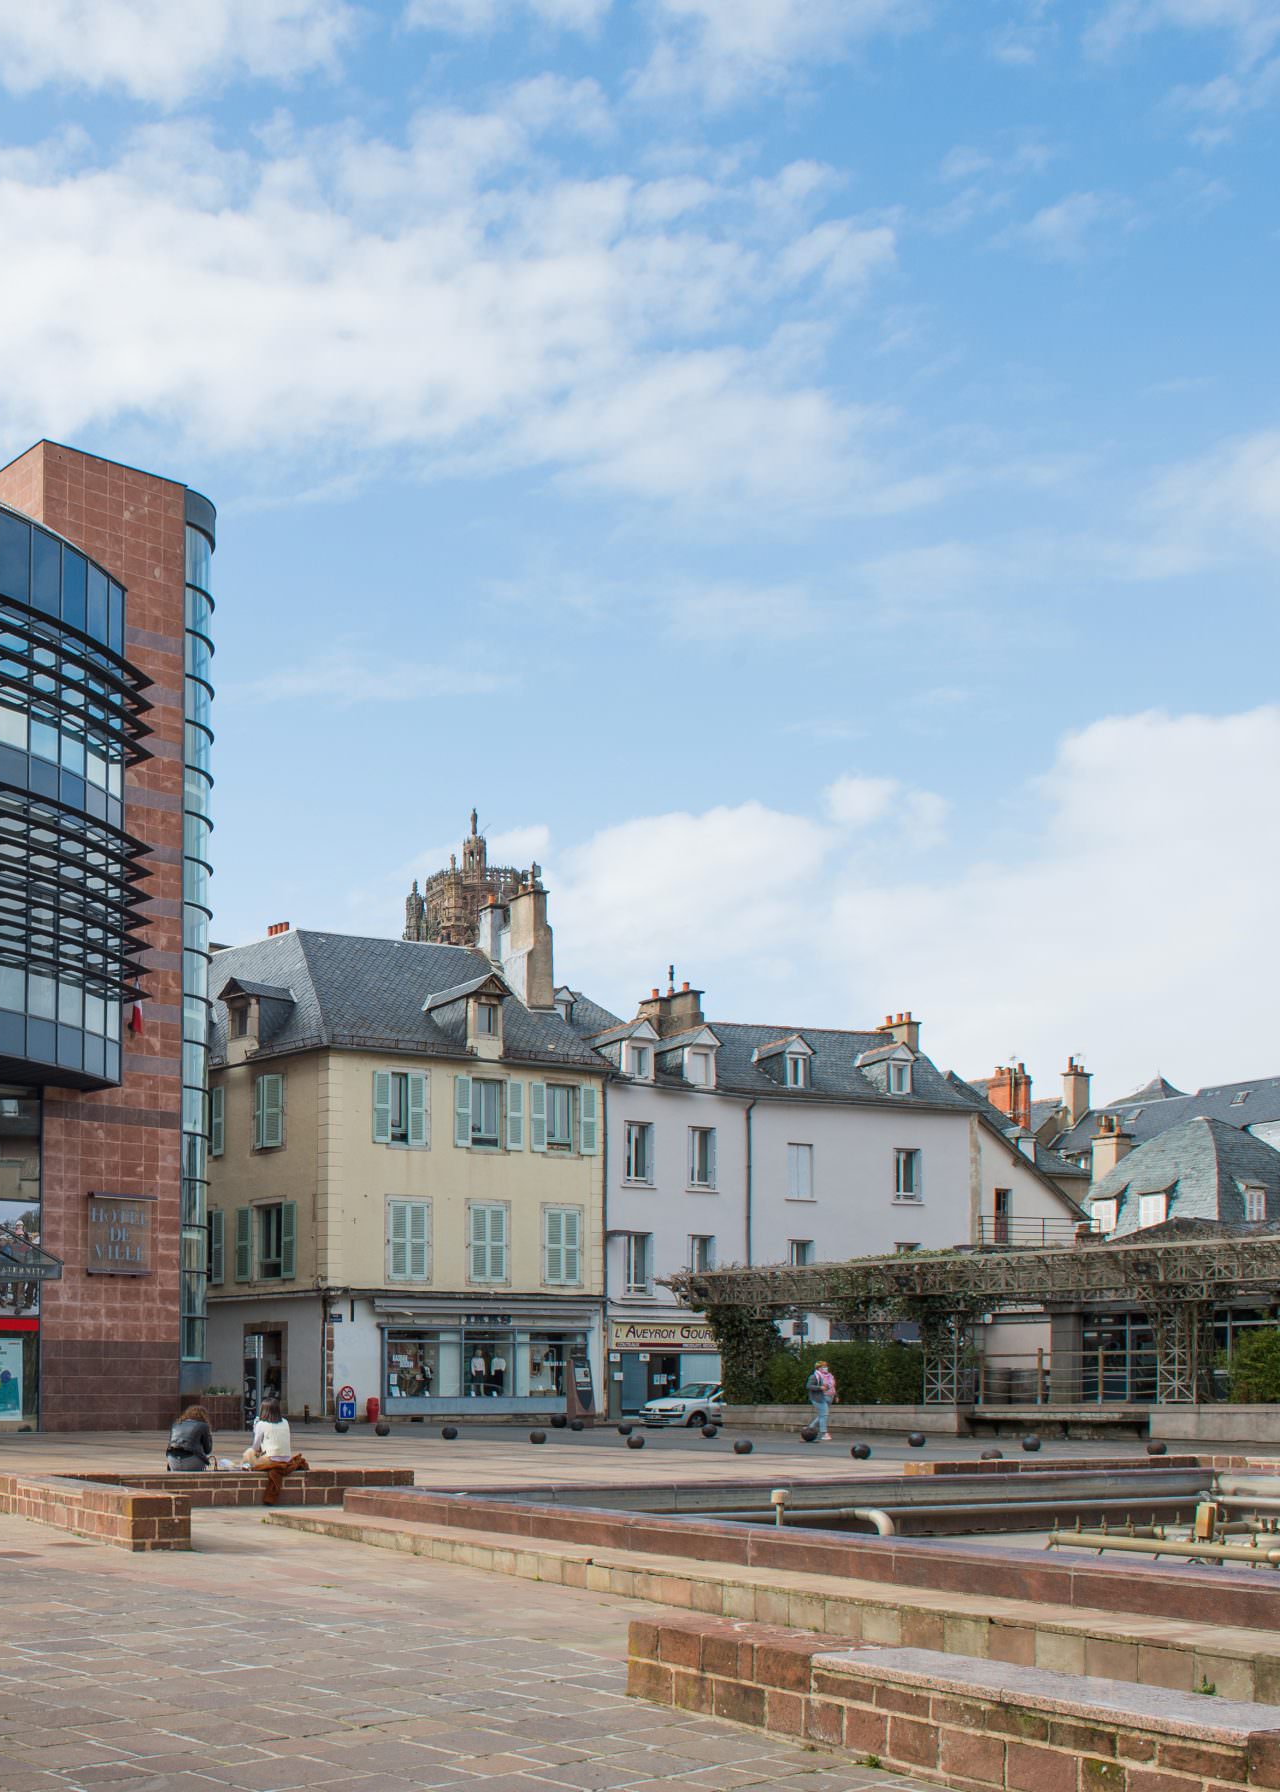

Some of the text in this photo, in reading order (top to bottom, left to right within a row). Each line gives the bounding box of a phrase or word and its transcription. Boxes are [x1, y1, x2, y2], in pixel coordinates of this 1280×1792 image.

[110, 1226, 128, 1241] DE
[95, 1243, 145, 1261] VILLE
[626, 1325, 675, 1339] AVEYRON
[680, 1326, 713, 1339] GOUR
